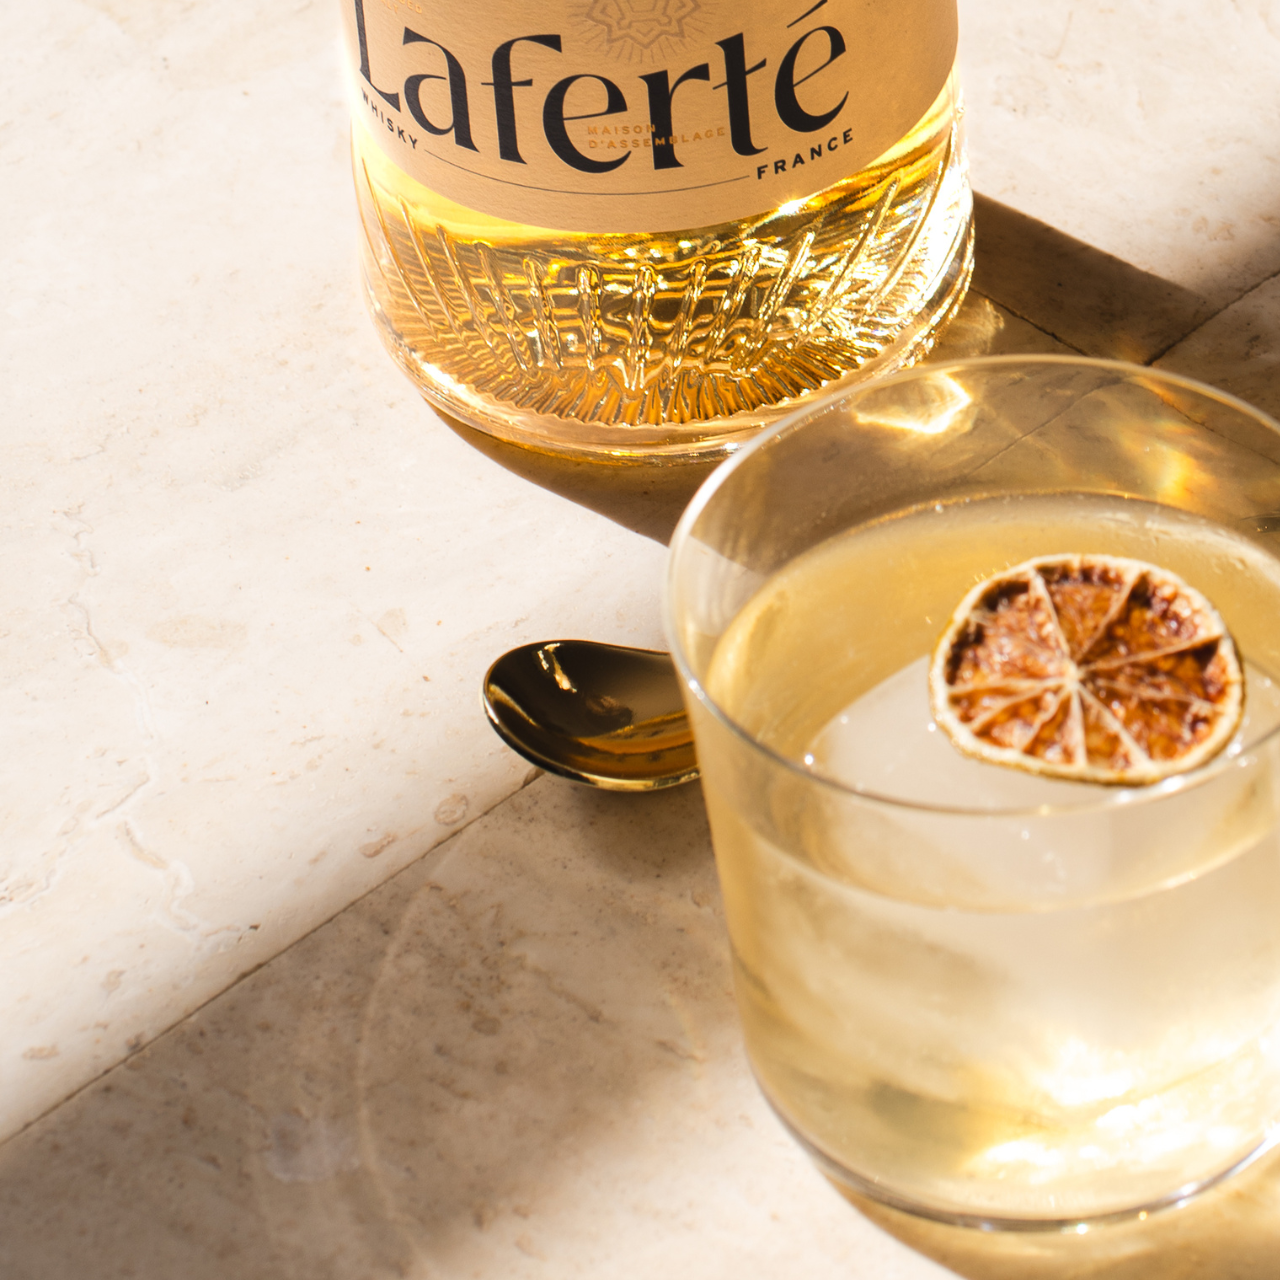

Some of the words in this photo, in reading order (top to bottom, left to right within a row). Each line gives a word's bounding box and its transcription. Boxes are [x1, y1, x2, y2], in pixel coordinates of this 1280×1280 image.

[361, 86, 418, 150] WHISKY
[756, 127, 854, 181] FRANCE
[587, 123, 656, 136] MAISON
[588, 126, 726, 149] D'ASSEMBLAGE
